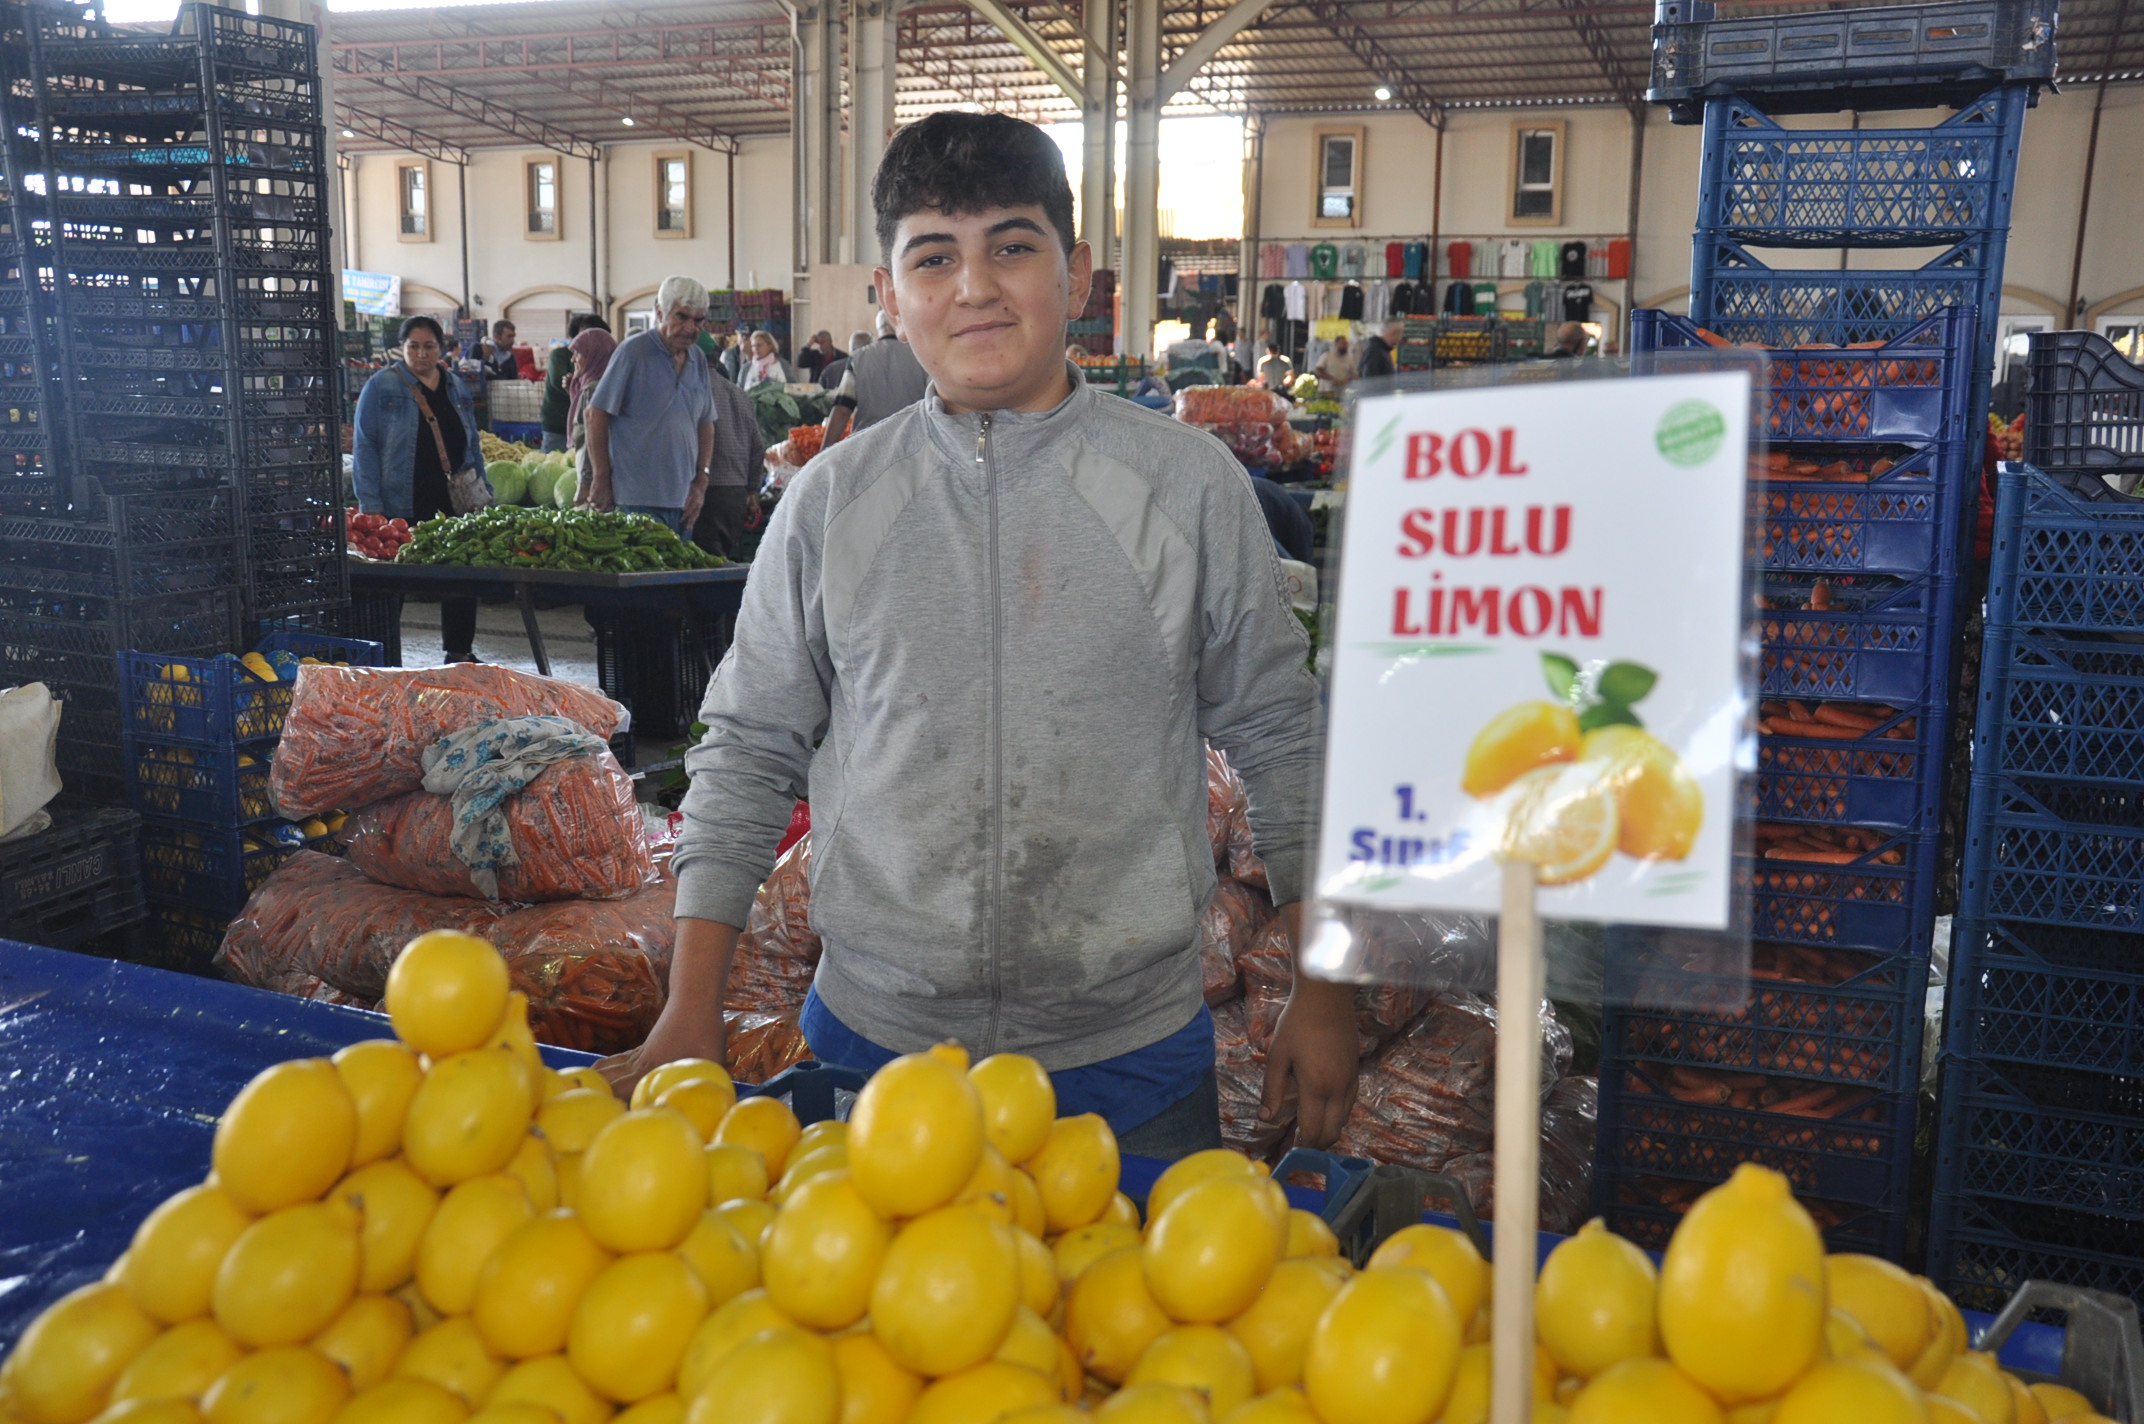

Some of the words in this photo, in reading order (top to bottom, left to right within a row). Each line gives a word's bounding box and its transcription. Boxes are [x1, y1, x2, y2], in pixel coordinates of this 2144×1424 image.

[1404, 427, 1529, 481] BOL
[1397, 505, 1572, 559] SULU
[1392, 571, 1605, 640] LİMON
[1395, 784, 1427, 820] 1.
[56, 854, 102, 889] CANLI
